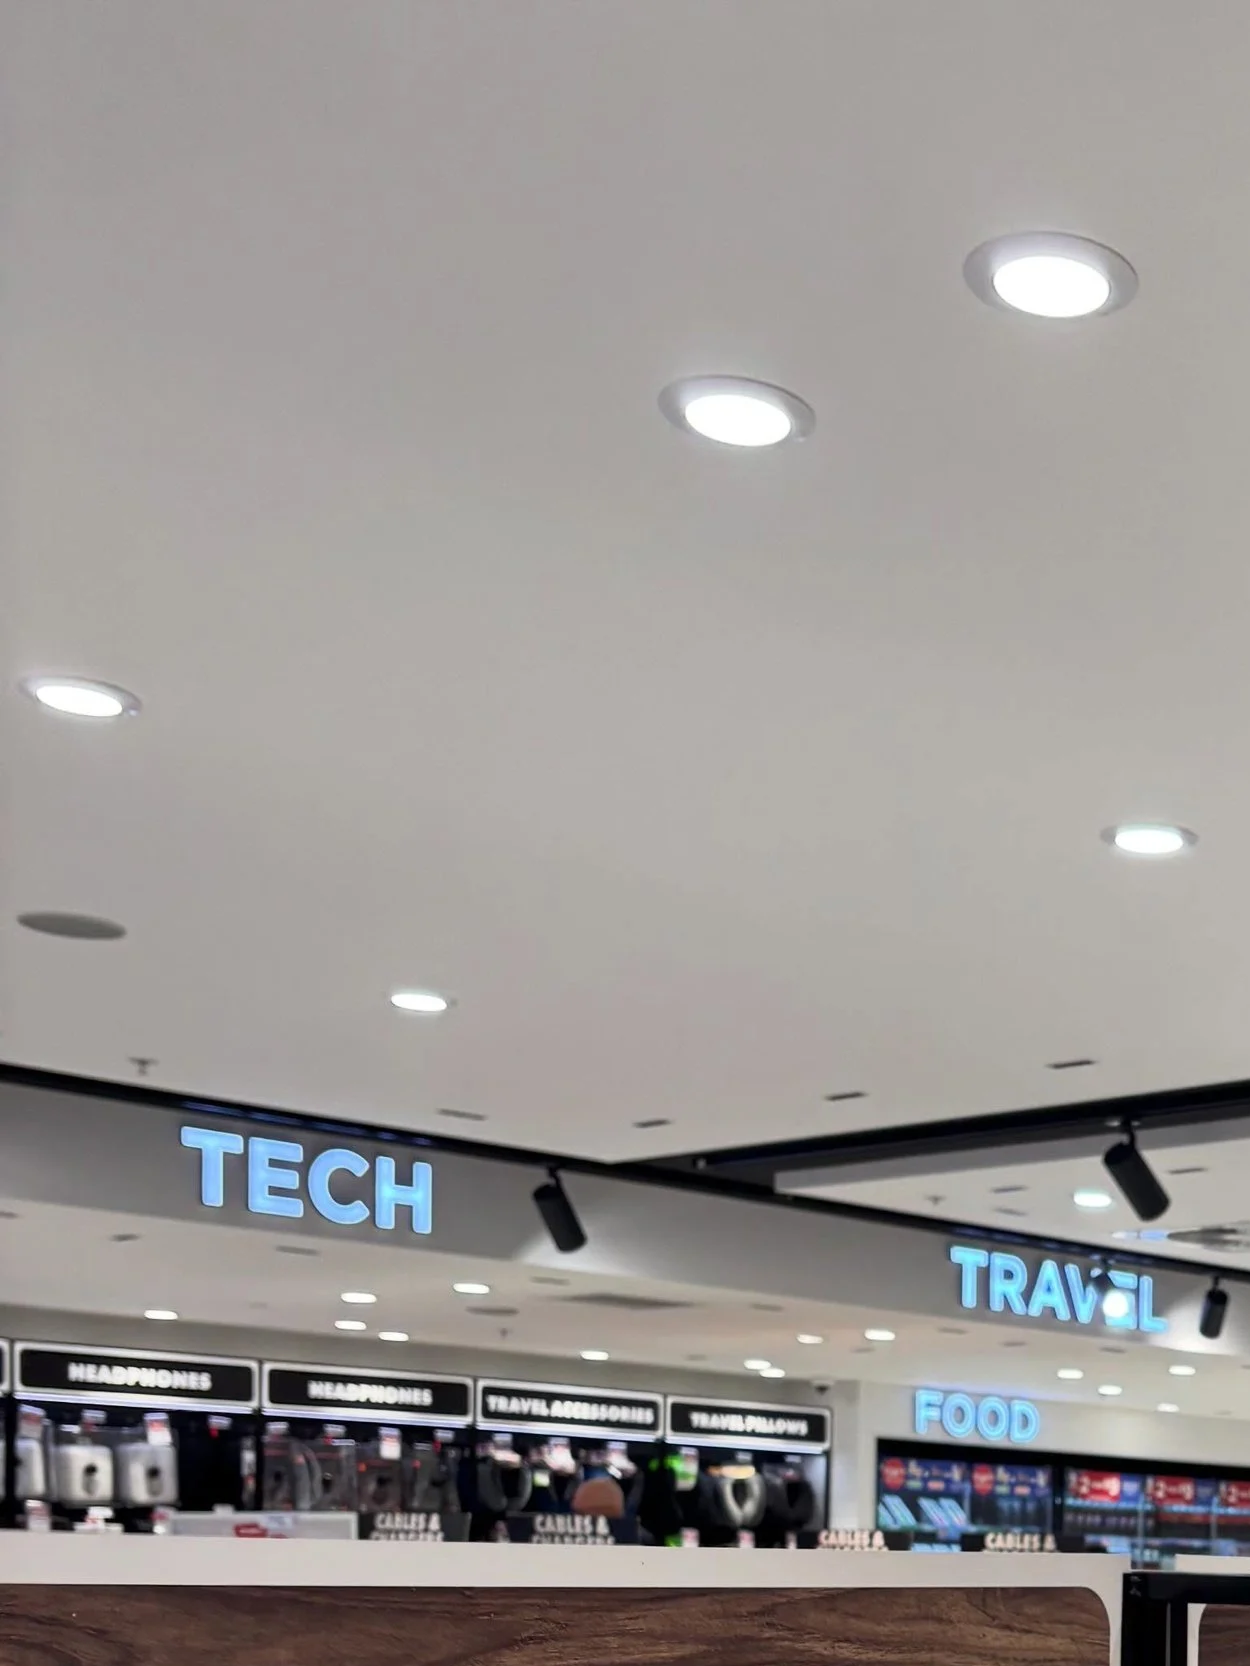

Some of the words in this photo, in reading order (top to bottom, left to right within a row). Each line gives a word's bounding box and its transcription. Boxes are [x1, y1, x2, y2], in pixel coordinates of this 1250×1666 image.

[181, 1126, 432, 1235] TECH
[950, 1246, 1169, 1334] TRAVEL
[67, 1362, 212, 1391] HEADPHONES
[307, 1381, 432, 1407] HEADPHONES
[486, 1394, 549, 1417] TRAVEL
[915, 1388, 1040, 1443] FOOD
